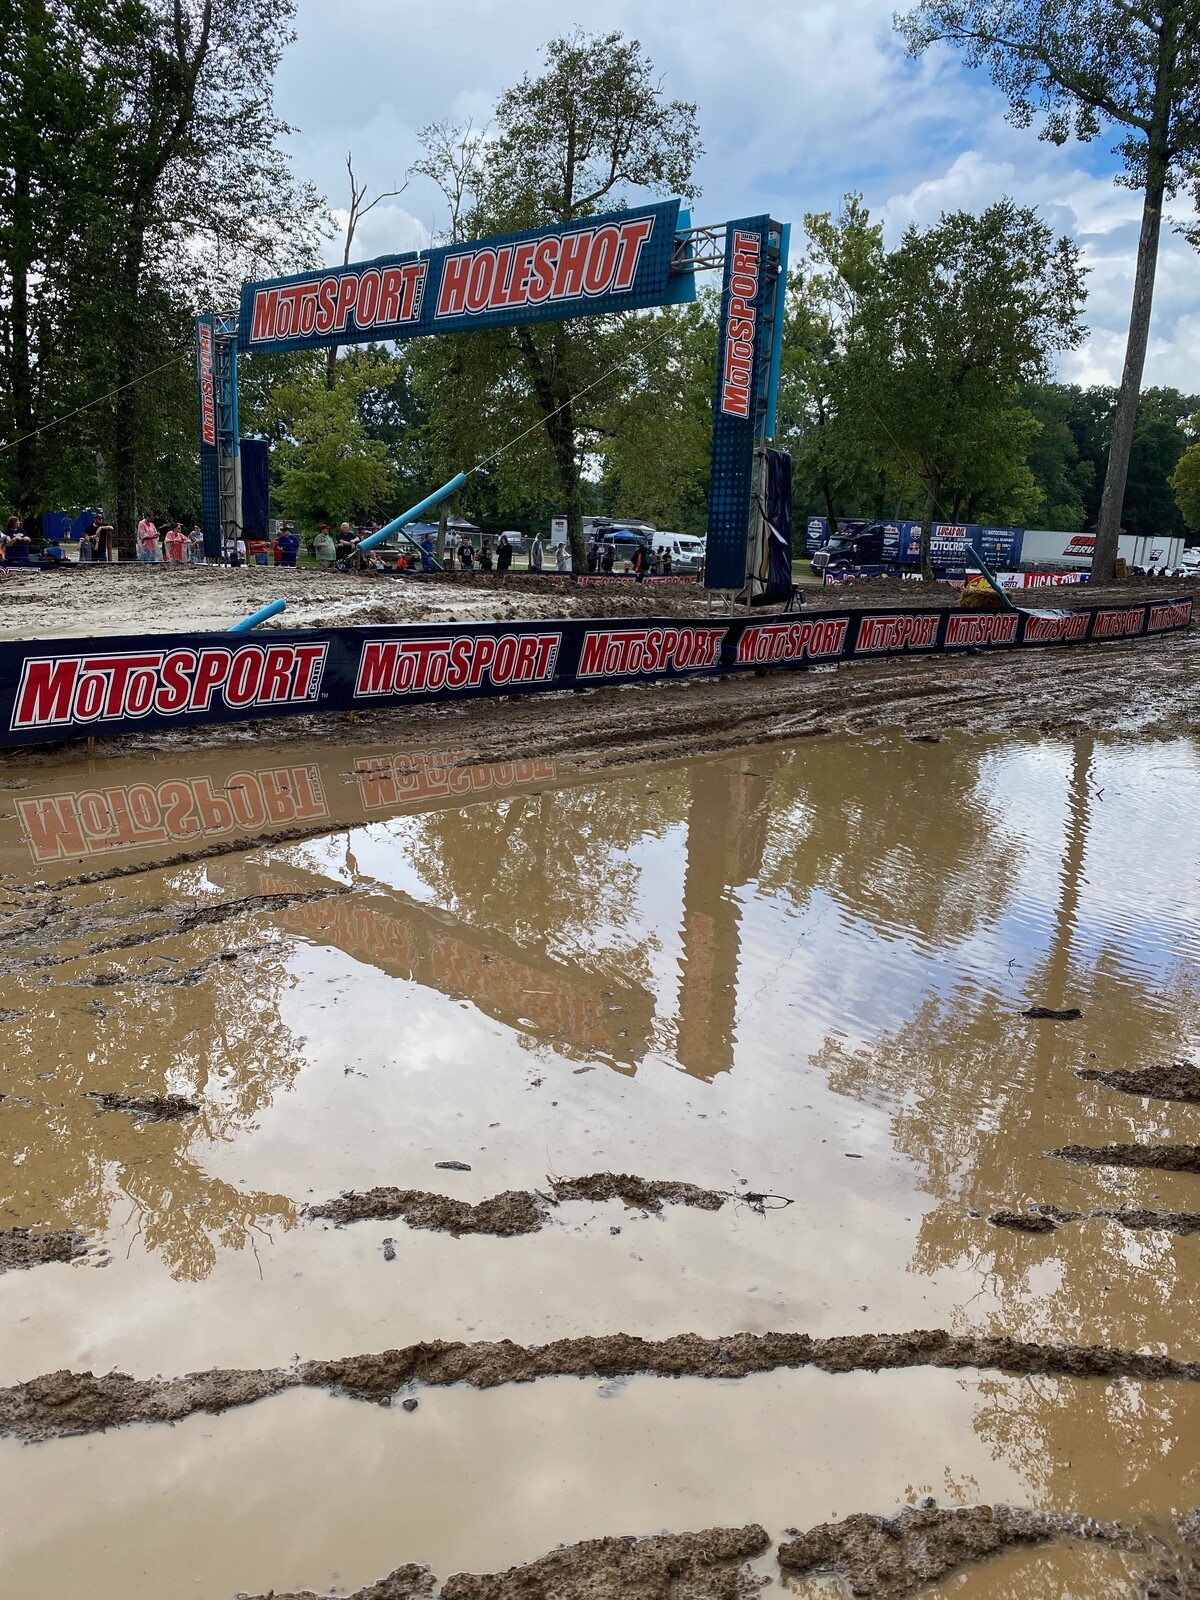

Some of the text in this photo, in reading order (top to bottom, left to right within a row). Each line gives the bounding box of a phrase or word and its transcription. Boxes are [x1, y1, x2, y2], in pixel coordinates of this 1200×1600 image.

[435, 216, 655, 318] HOLESHOT
[937, 526, 965, 537] LUCAS OIL
[1070, 535, 1097, 545] GEA
[930, 541, 973, 551] OTOCRO
[1066, 545, 1095, 554] SERV
